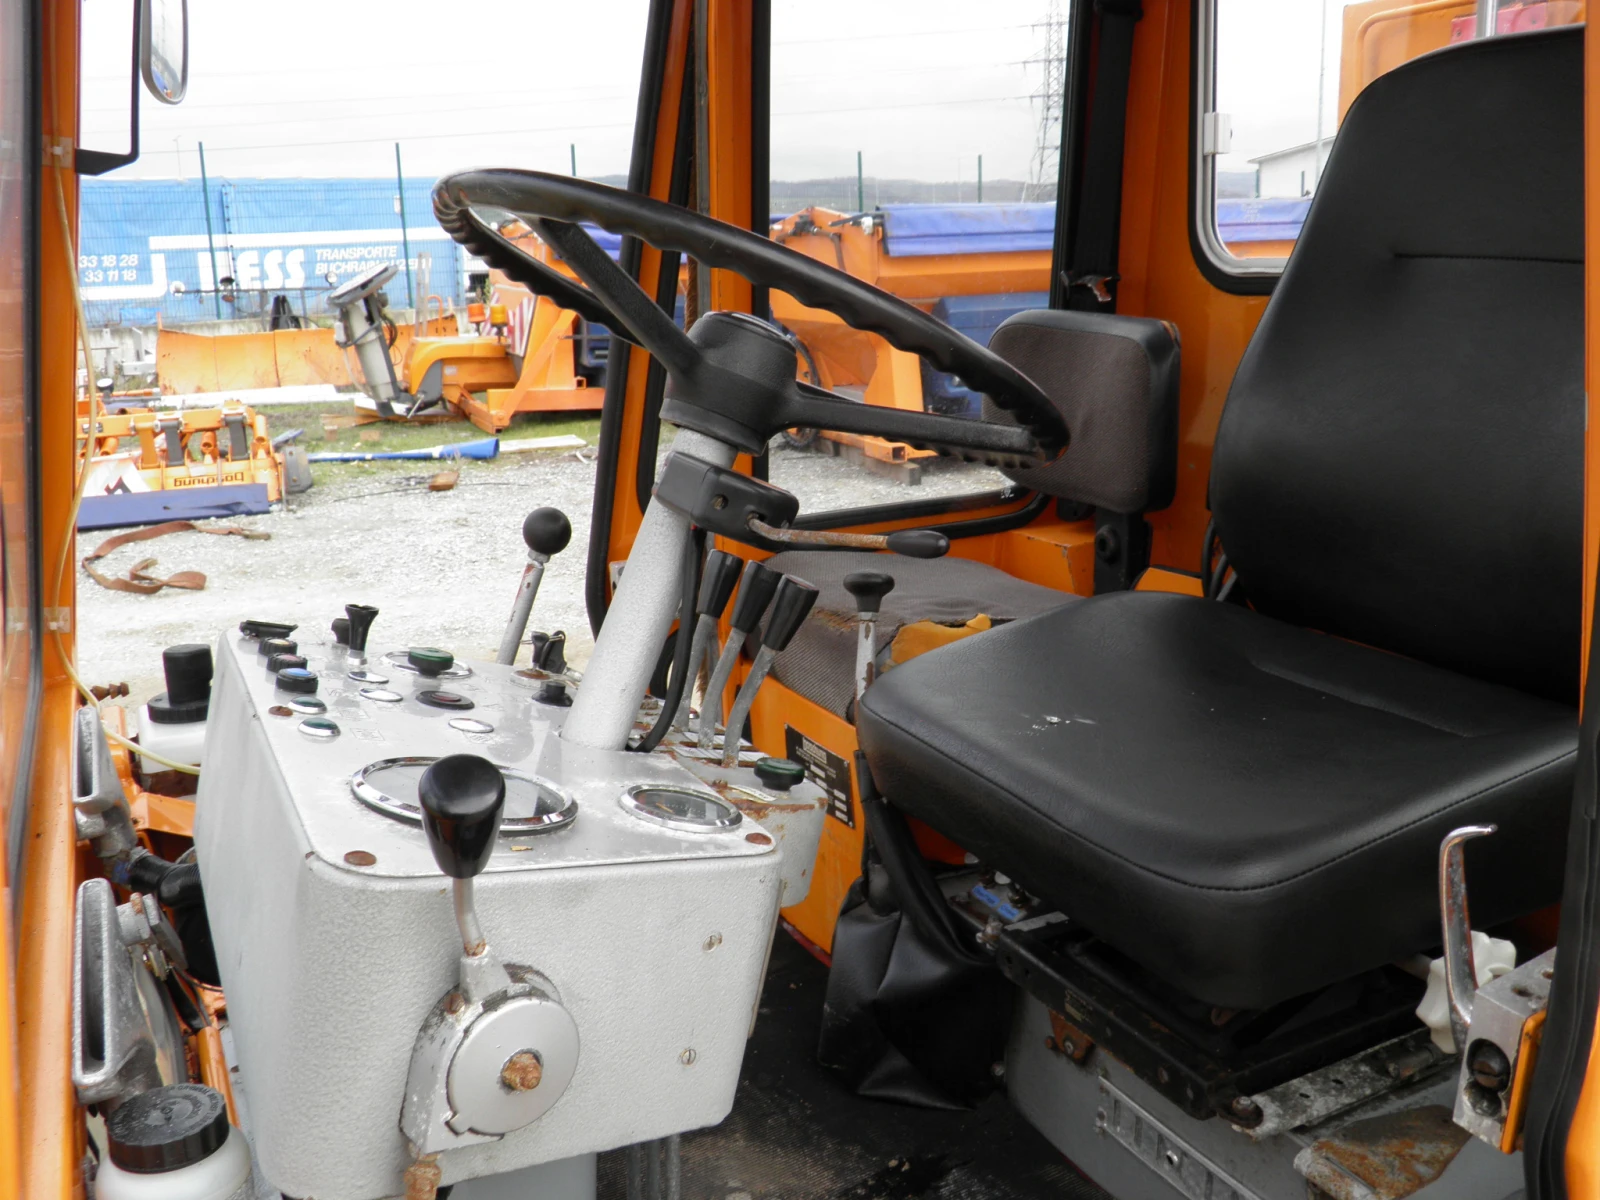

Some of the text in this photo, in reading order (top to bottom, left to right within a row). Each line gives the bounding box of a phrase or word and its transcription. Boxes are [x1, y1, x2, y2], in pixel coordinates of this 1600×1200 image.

[79, 253, 138, 268] 33 18 28
[315, 245, 397, 261] TRANSPORTE
[84, 268, 137, 283] 33 11 18
